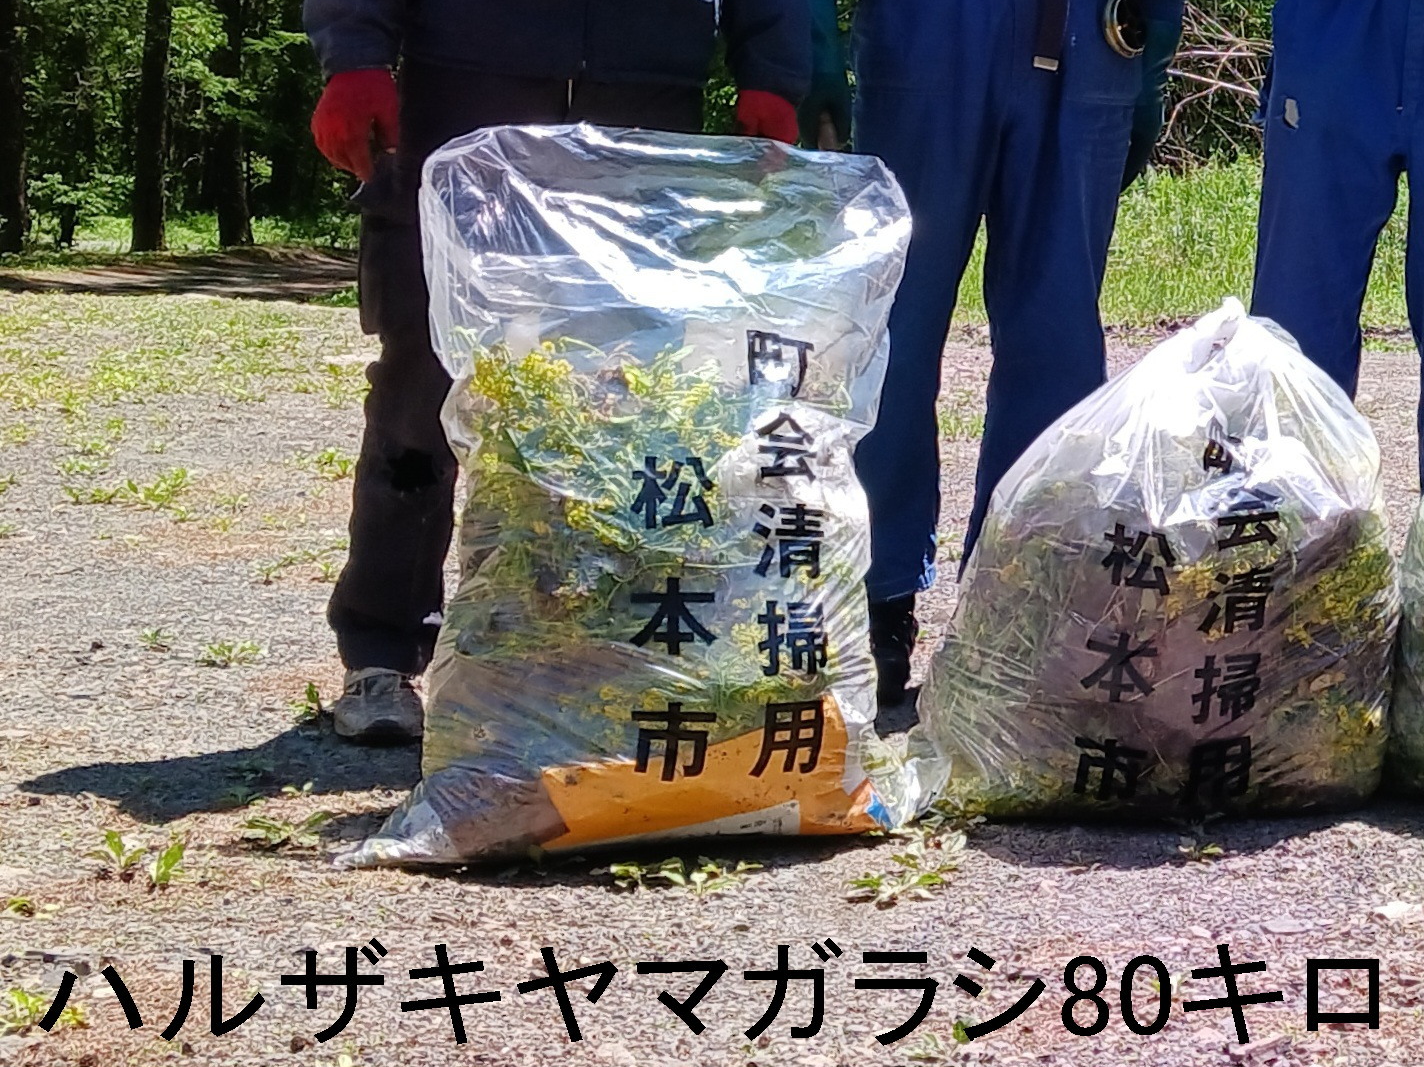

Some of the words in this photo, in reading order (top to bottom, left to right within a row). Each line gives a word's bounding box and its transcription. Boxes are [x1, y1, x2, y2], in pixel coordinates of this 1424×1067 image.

[630, 455, 718, 783] 松本市
[747, 329, 830, 778] 町会清掃用
[1073, 523, 1176, 800] 松本市
